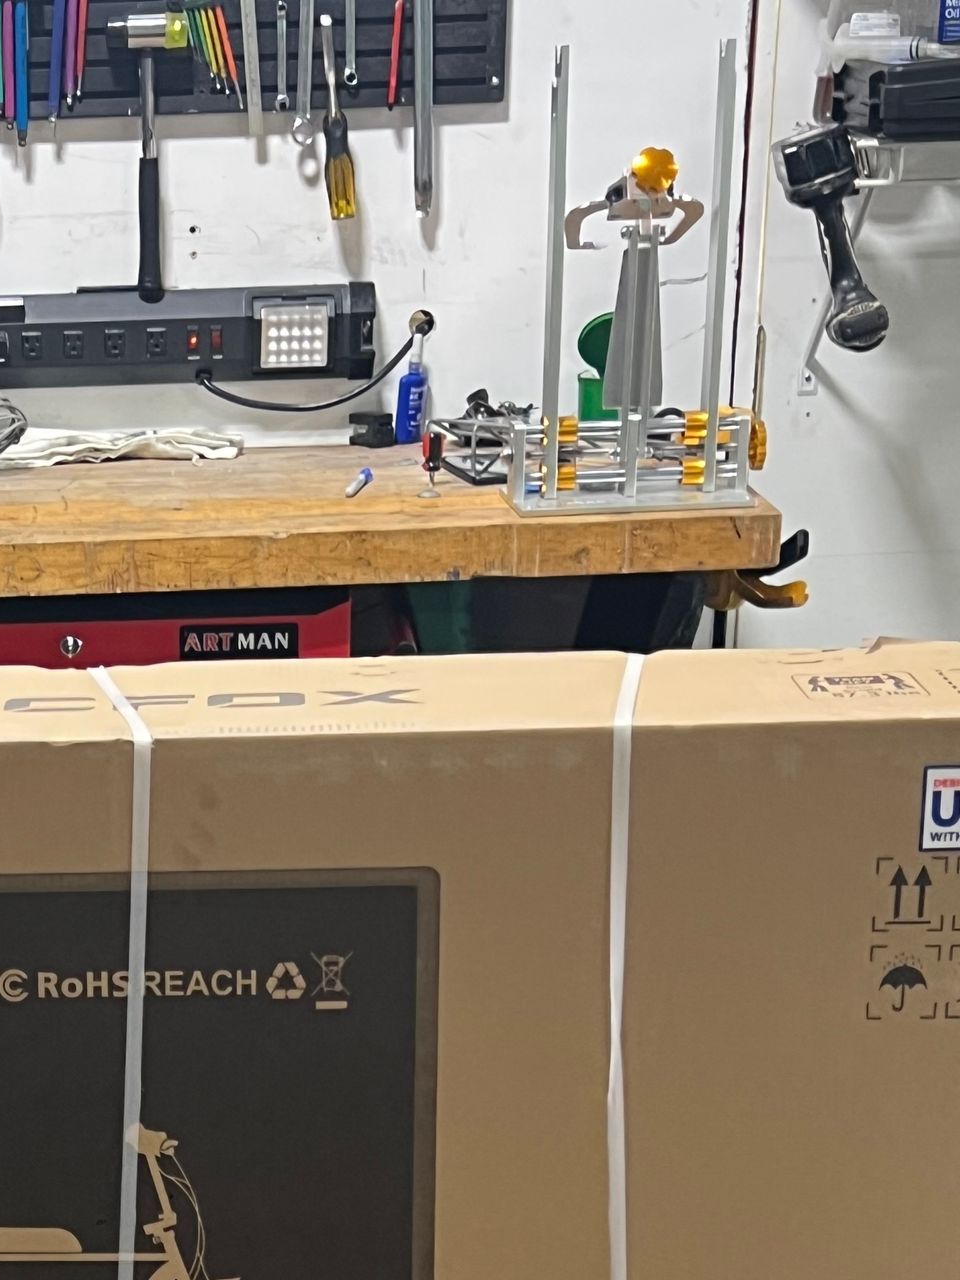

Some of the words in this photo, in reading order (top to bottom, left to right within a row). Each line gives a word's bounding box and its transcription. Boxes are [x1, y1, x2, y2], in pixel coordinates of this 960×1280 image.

[184, 632, 289, 652] ARTMAN
[37, 970, 130, 998] RoHS
[144, 969, 257, 996] REACH
